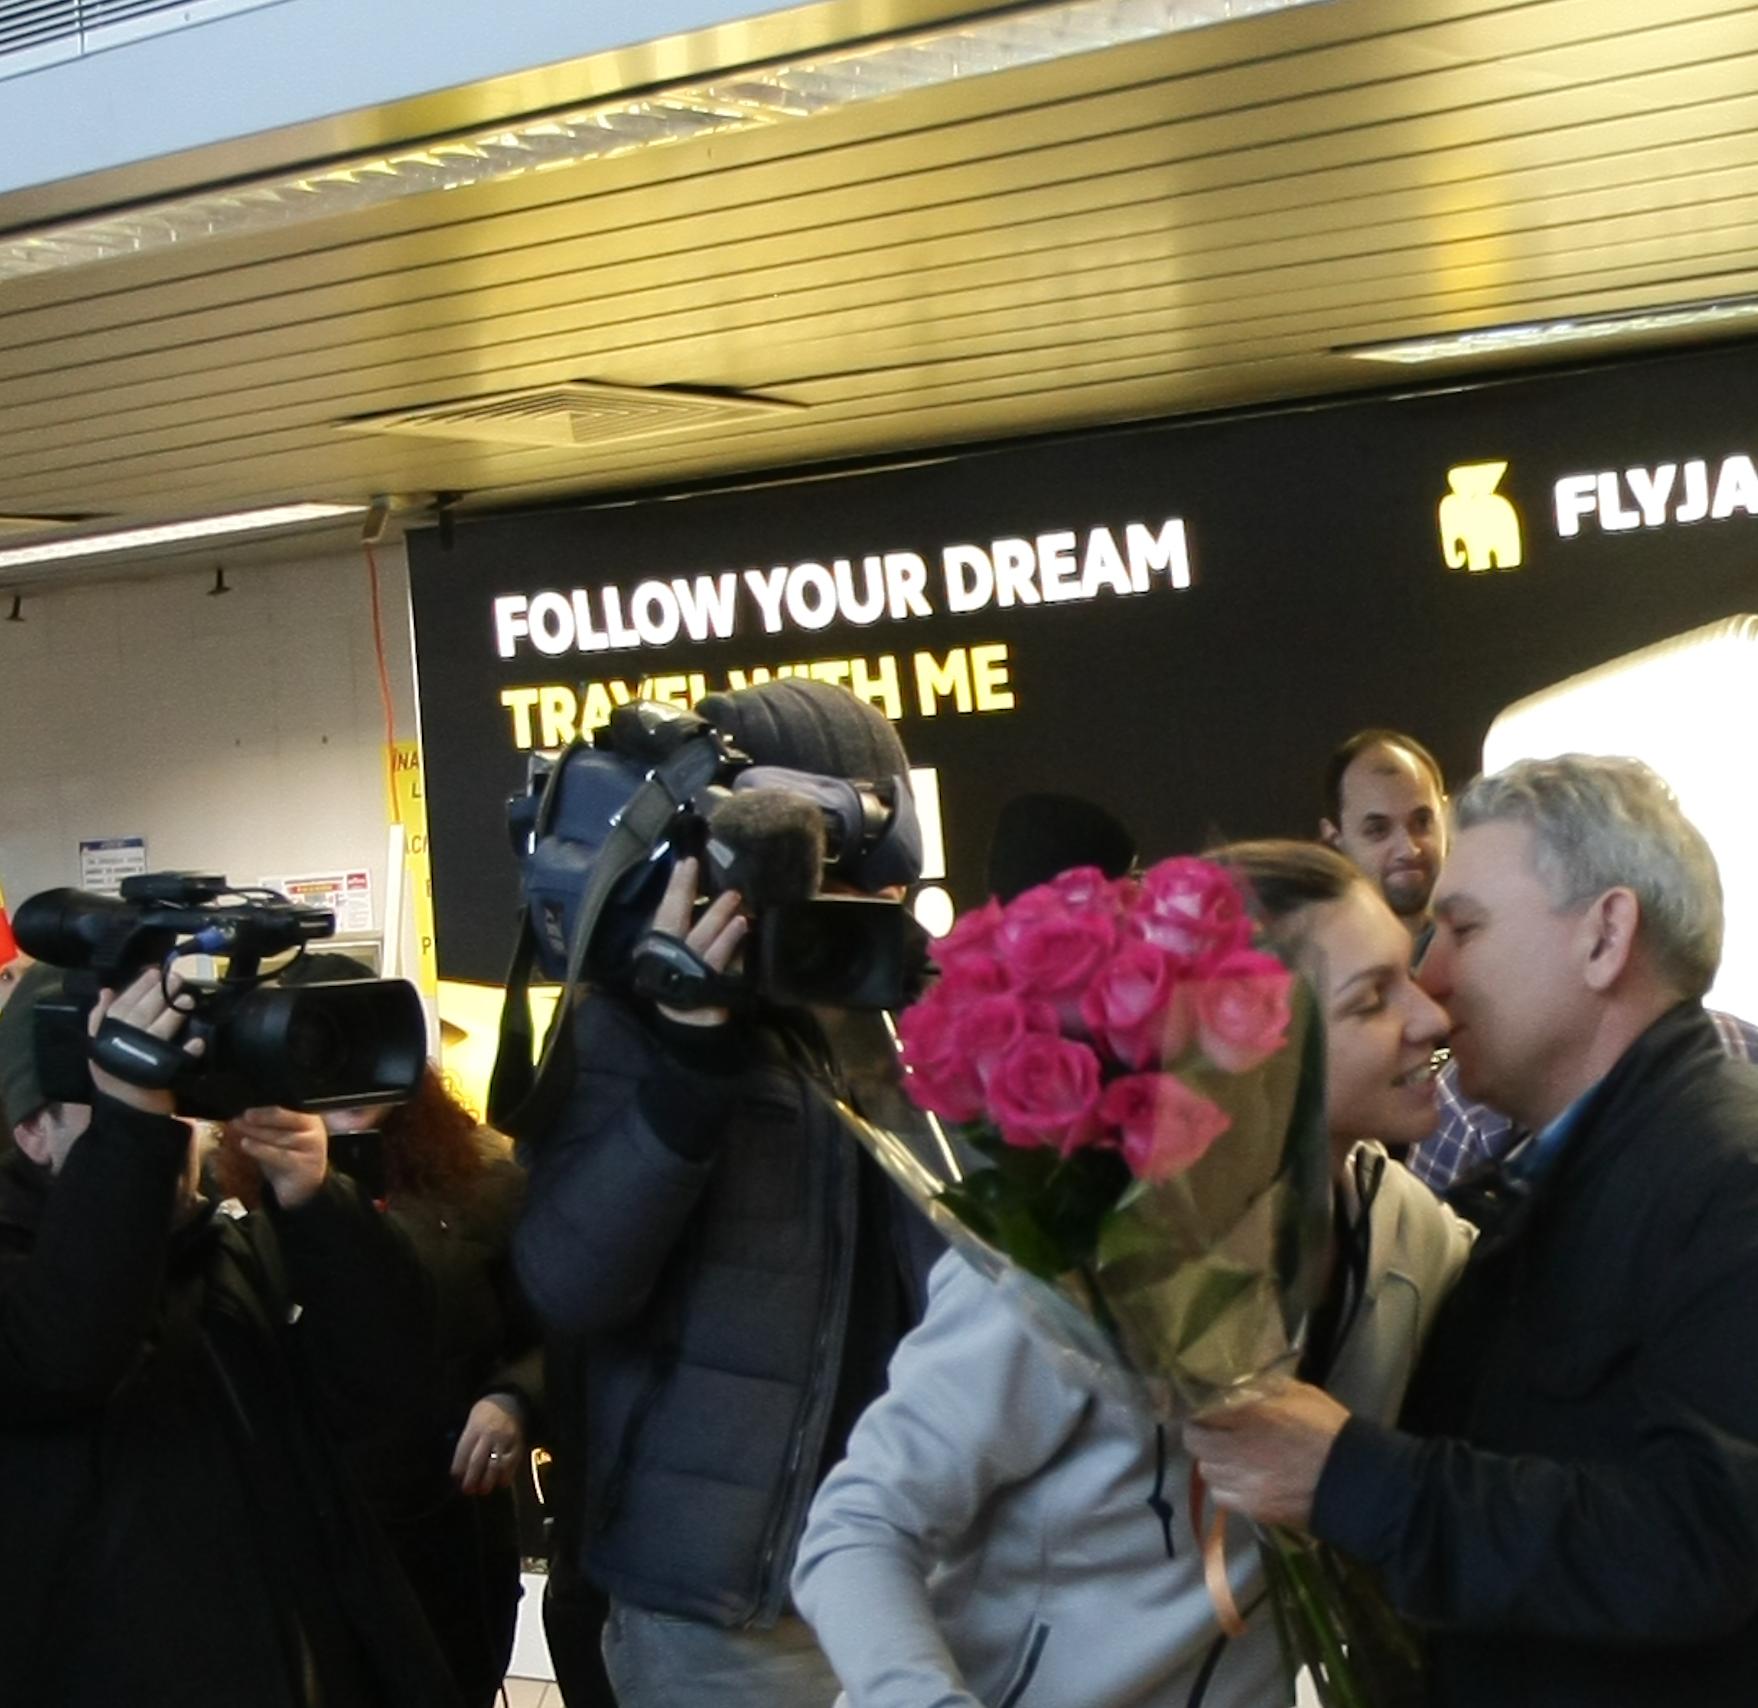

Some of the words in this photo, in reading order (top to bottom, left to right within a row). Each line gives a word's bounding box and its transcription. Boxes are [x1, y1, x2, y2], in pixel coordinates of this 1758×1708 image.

[493, 572, 737, 658] FOLLOW
[743, 552, 933, 633] YOUR
[942, 518, 1191, 613] DREAM
[914, 644, 1014, 716] ME
